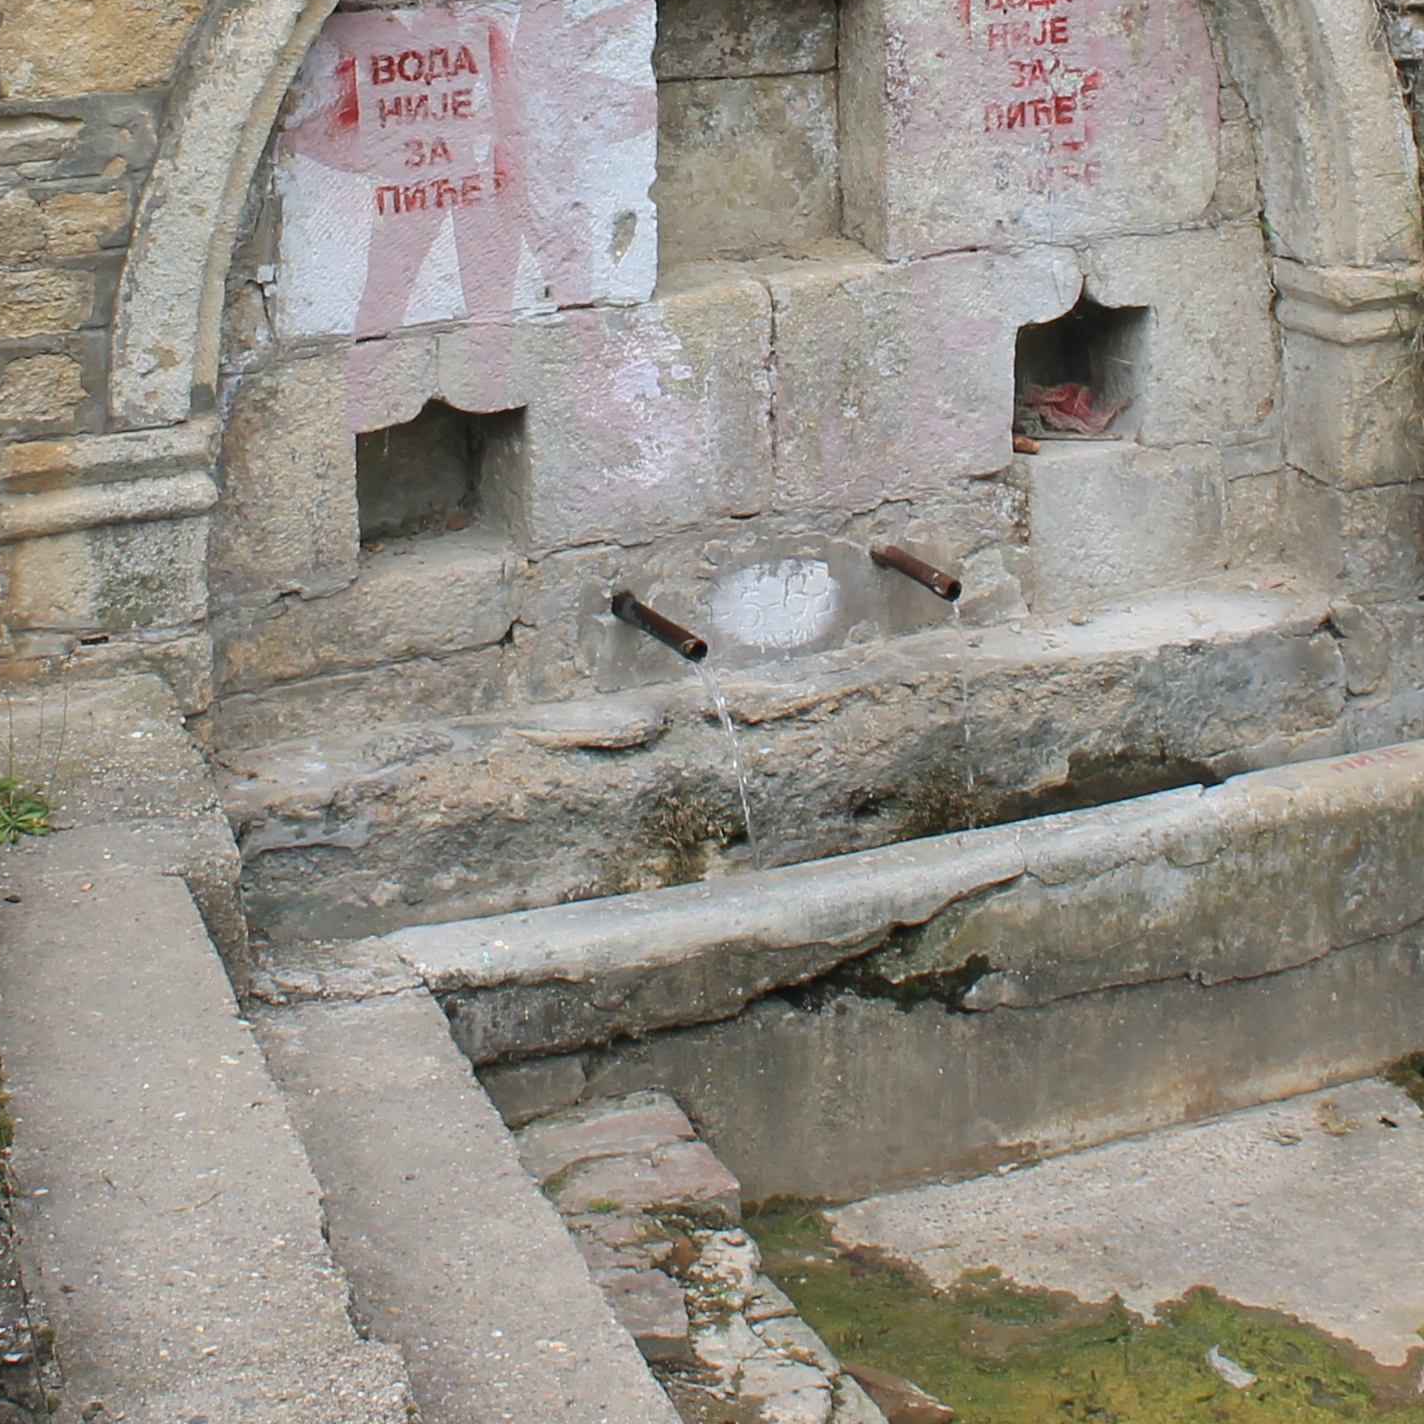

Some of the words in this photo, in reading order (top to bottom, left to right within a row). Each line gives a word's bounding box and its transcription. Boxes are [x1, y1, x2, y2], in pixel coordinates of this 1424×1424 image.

[987, 16, 1069, 51] НИЈЕ
[371, 44, 479, 86] ВОДА
[1008, 59, 1052, 89] ЗА
[378, 88, 474, 128] НИЈЕ
[983, 94, 1077, 133] ПИЋЕ
[403, 136, 453, 168] ЗА
[376, 173, 483, 216] ПИЋЕ
